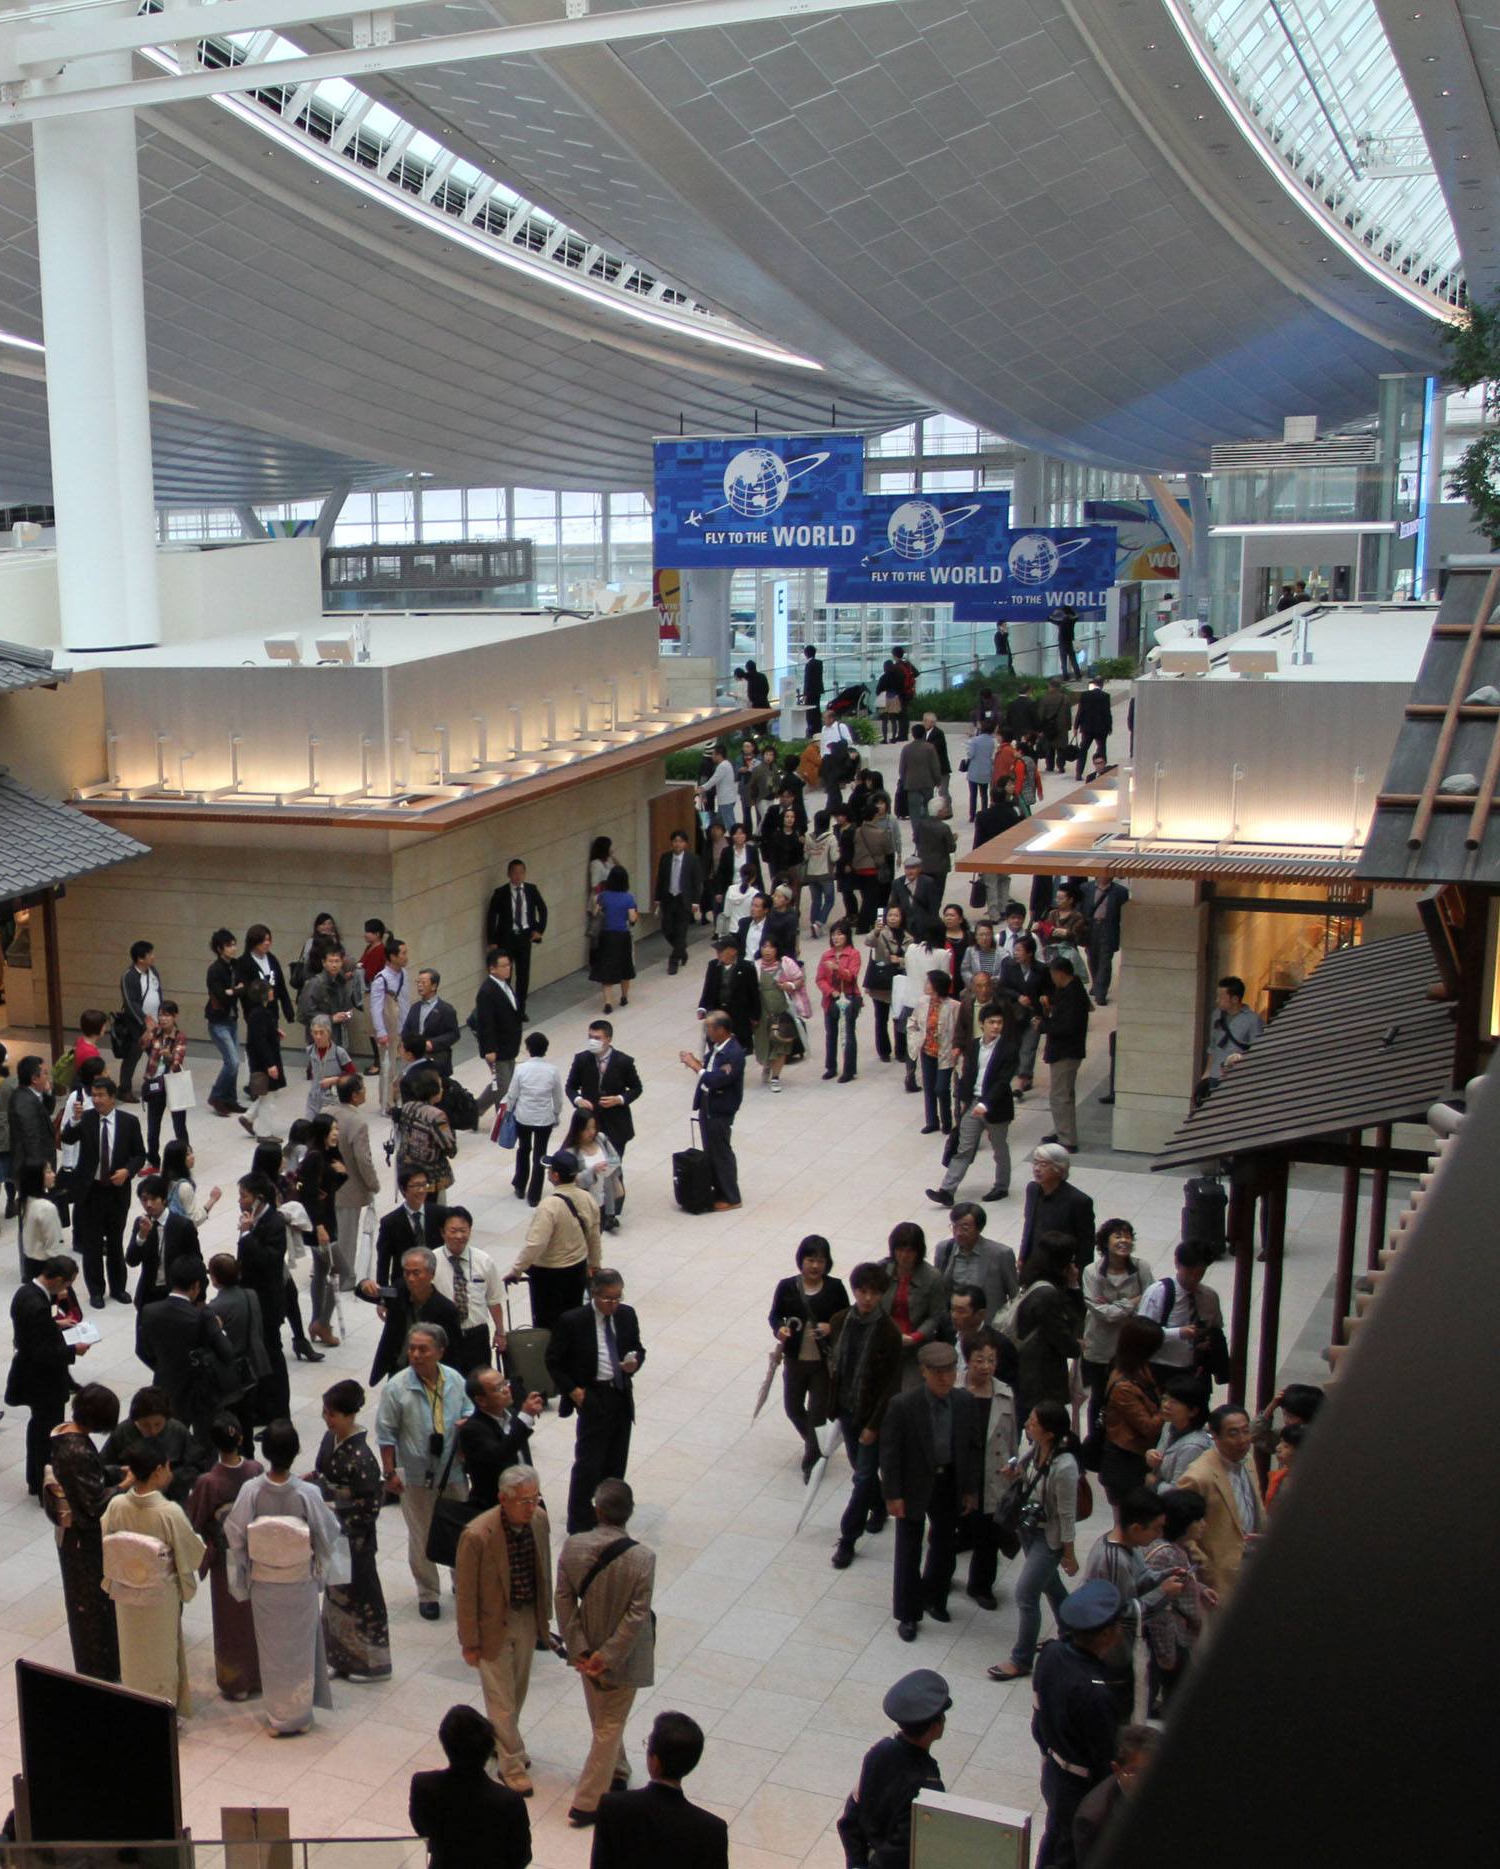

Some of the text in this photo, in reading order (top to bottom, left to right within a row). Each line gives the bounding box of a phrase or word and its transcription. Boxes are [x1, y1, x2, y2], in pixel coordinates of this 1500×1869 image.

[705, 525, 856, 547] FLY TO THE WORLD
[871, 566, 1003, 585] FLY TO THE WORLD
[777, 589, 785, 614] E
[1011, 595, 1023, 604] TO
[1025, 595, 1042, 604] THE
[1045, 591, 1107, 607] WORLD
